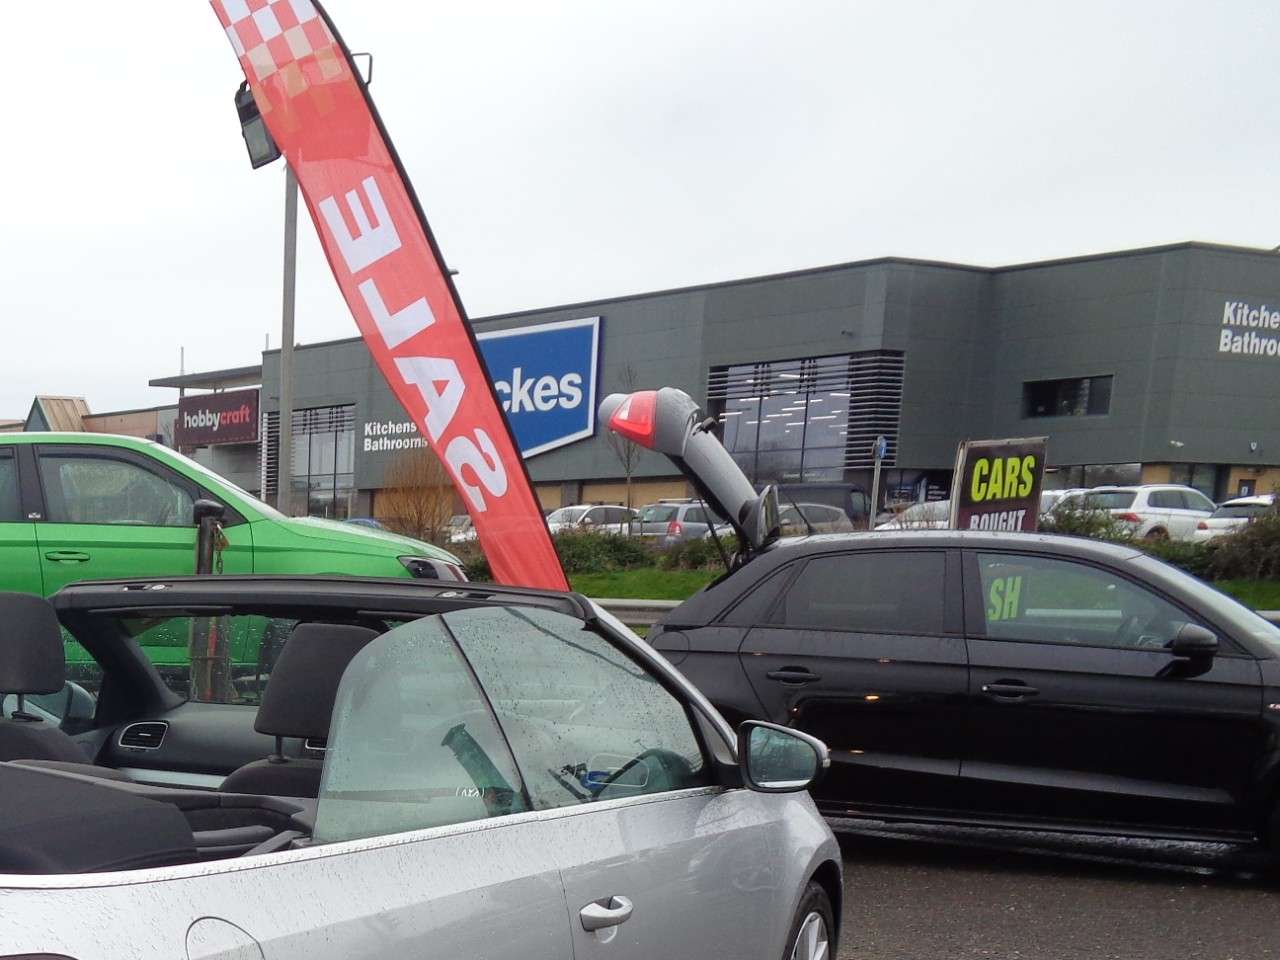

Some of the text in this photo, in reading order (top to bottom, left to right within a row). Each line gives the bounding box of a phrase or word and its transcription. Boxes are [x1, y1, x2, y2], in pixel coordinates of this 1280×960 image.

[1223, 301, 1280, 329] Kitche
[1219, 329, 1280, 357] Bathro
[494, 367, 582, 413] ckes
[184, 404, 250, 431] hobbycraft
[364, 420, 417, 436] Kitchens
[364, 436, 429, 451] Bathrooms
[971, 455, 1035, 502] CARS
[988, 576, 1022, 621] SH
